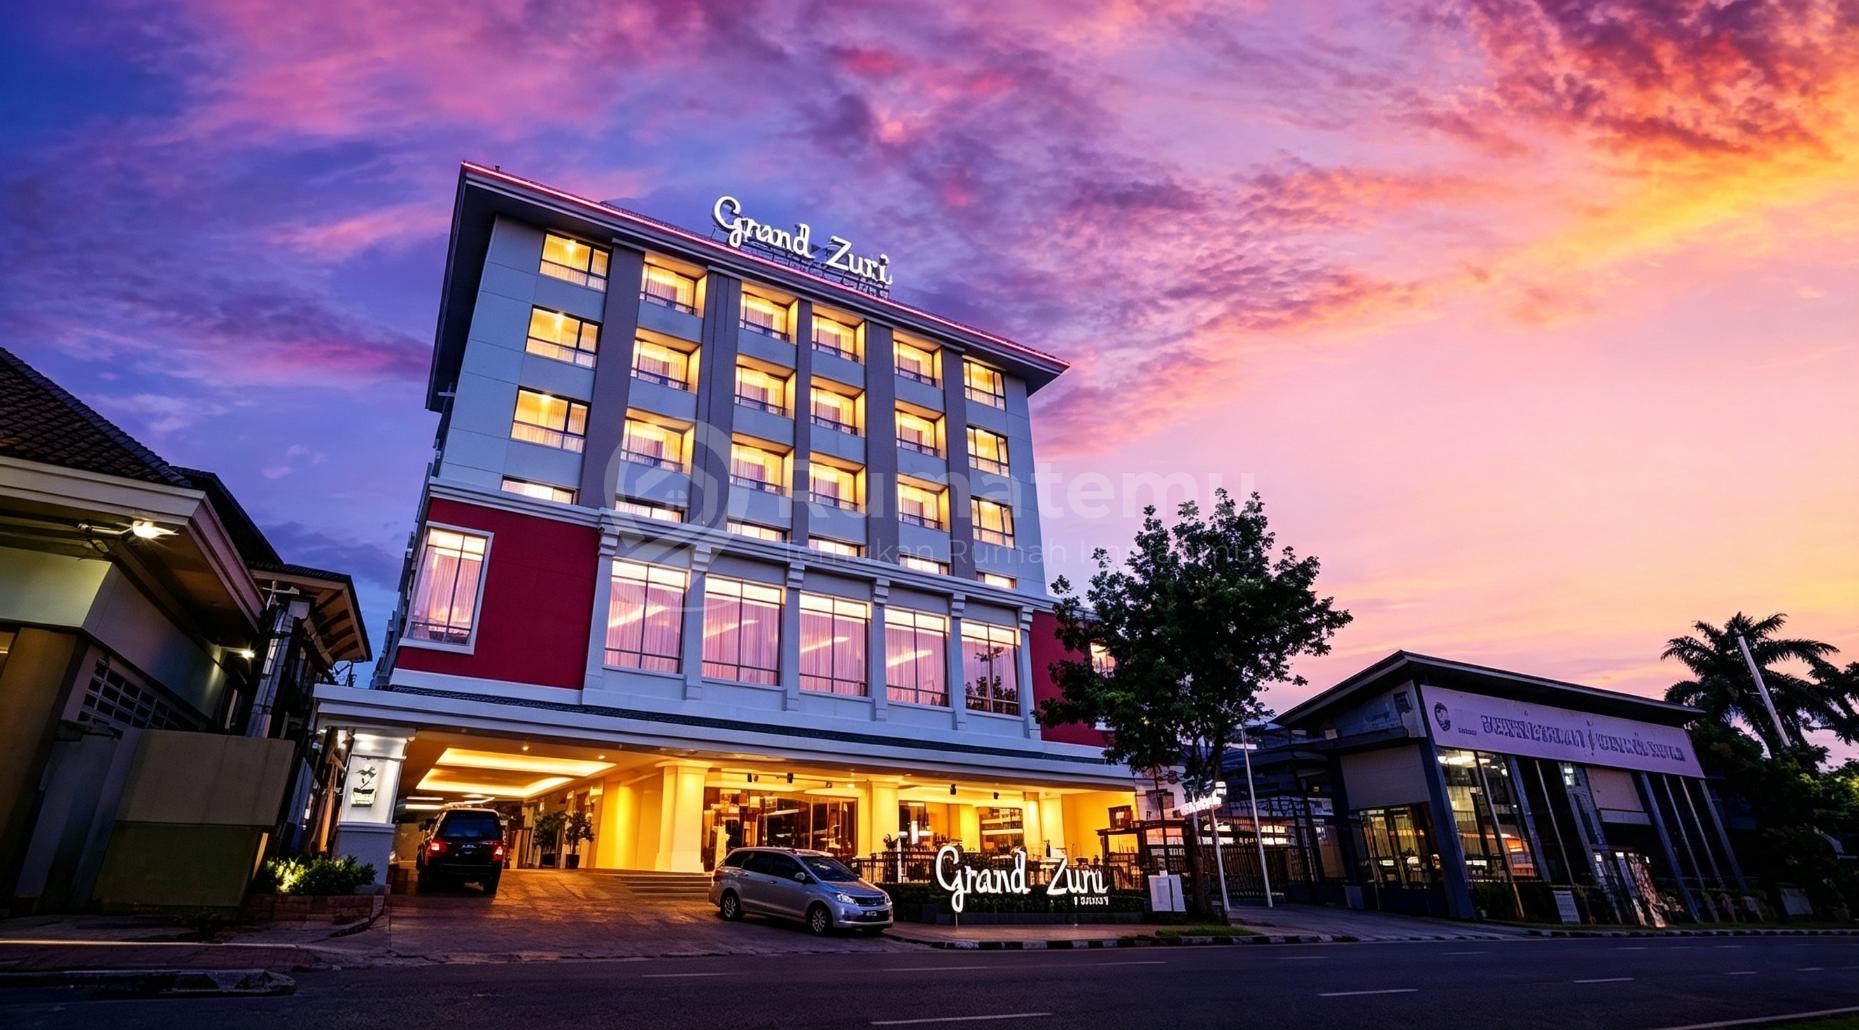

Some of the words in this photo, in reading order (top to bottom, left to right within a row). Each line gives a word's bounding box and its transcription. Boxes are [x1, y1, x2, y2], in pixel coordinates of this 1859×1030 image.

[711, 195, 814, 259] Grand
[826, 235, 893, 285] Zuri
[935, 845, 1030, 913] Grand
